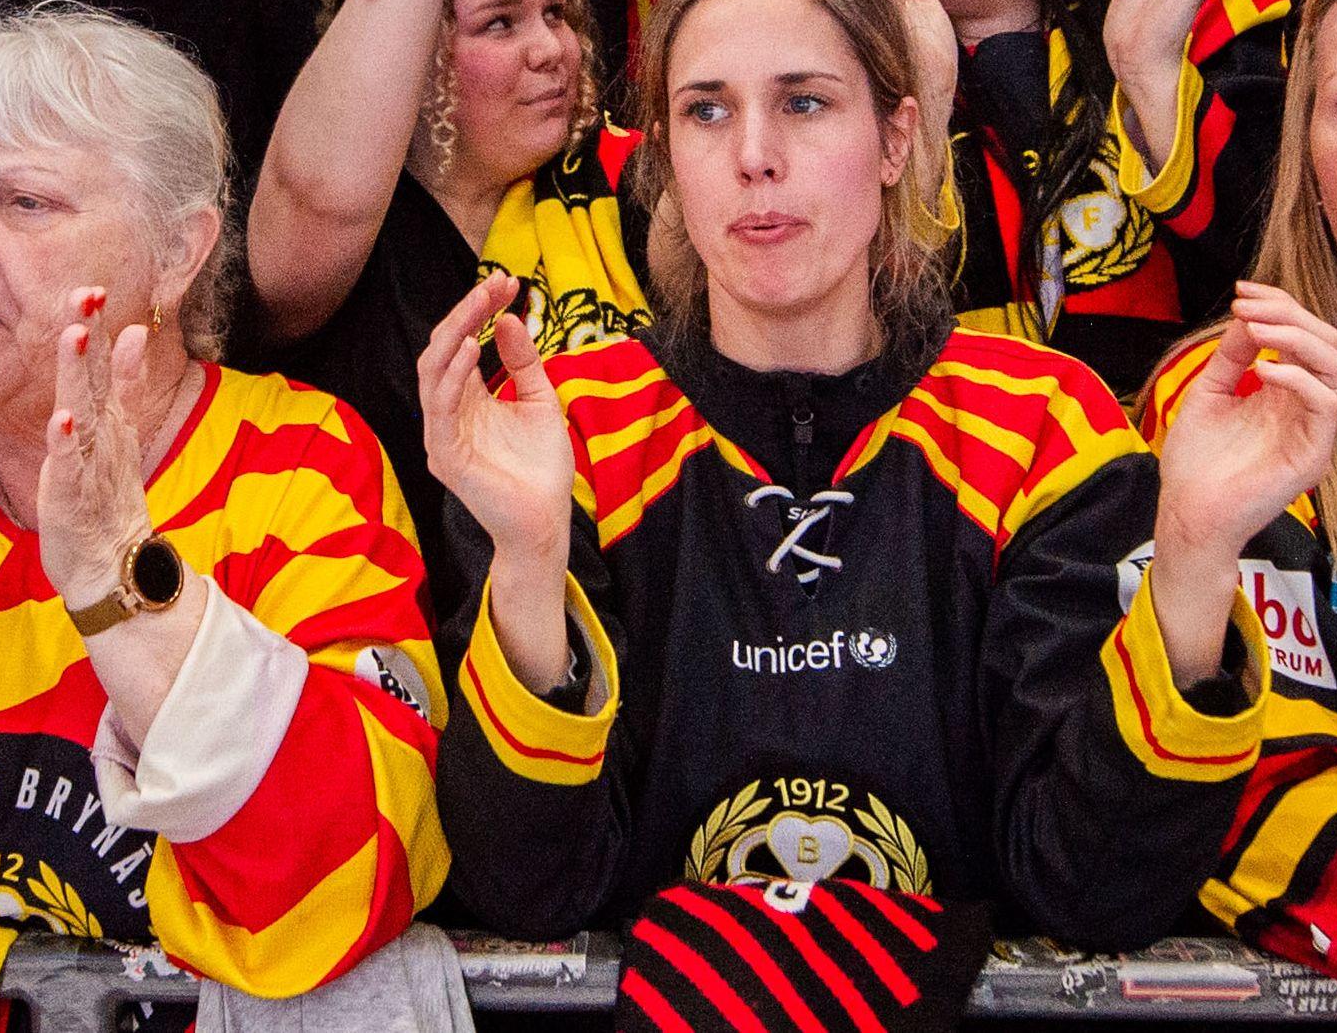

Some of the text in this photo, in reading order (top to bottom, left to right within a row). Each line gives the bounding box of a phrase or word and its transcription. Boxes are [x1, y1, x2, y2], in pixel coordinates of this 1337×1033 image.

[732, 630, 845, 674] unicef
[773, 777, 850, 812] 1912
[797, 836, 819, 864] B
